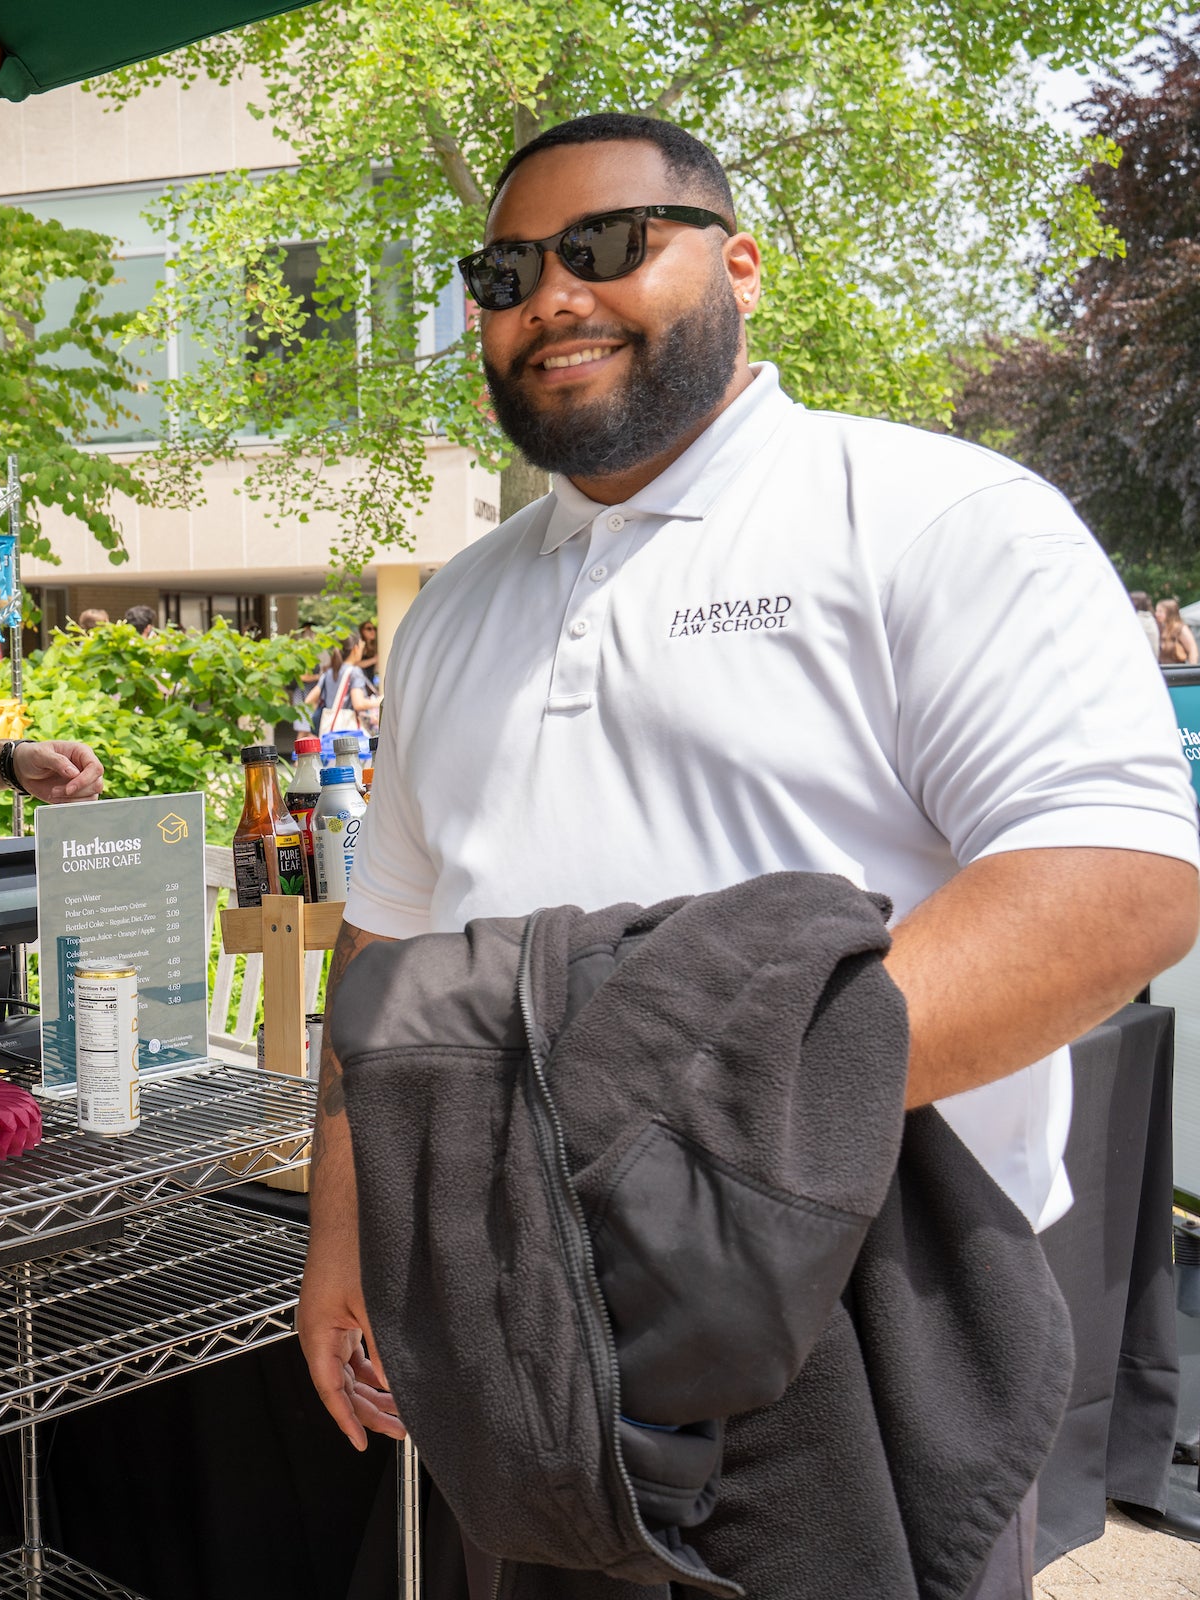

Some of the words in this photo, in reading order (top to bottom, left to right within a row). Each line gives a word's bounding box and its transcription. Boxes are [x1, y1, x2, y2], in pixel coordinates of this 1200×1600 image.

[672, 595, 792, 626] HARVARD
[669, 622, 706, 638] LAW
[711, 615, 789, 634] SCHOOL
[62, 837, 142, 858] Harkness
[280, 848, 300, 861] PURE
[62, 857, 110, 873] CORNER
[112, 853, 142, 868] CAFE
[281, 860, 301, 872] LEAF
[65, 896, 82, 905] Open
[82, 894, 101, 902] Water
[166, 883, 179, 891] 2.59
[65, 910, 81, 918] Polar
[82, 907, 95, 916] Can
[100, 904, 128, 914] Strawberry
[65, 922, 88, 932] Bottled
[89, 920, 104, 929] Coke
[166, 909, 180, 918] 3.09
[65, 936, 96, 945] Tropicana
[96, 932, 112, 941] Juice
[117, 929, 137, 938] Orange
[141, 926, 156, 936] Apple
[66, 950, 89, 959] Celsius
[166, 935, 180, 944] 4.09
[119, 949, 150, 960] Passionfruit
[168, 957, 181, 965] 4.69
[168, 970, 181, 978] 5.49
[168, 983, 181, 991] 4.69
